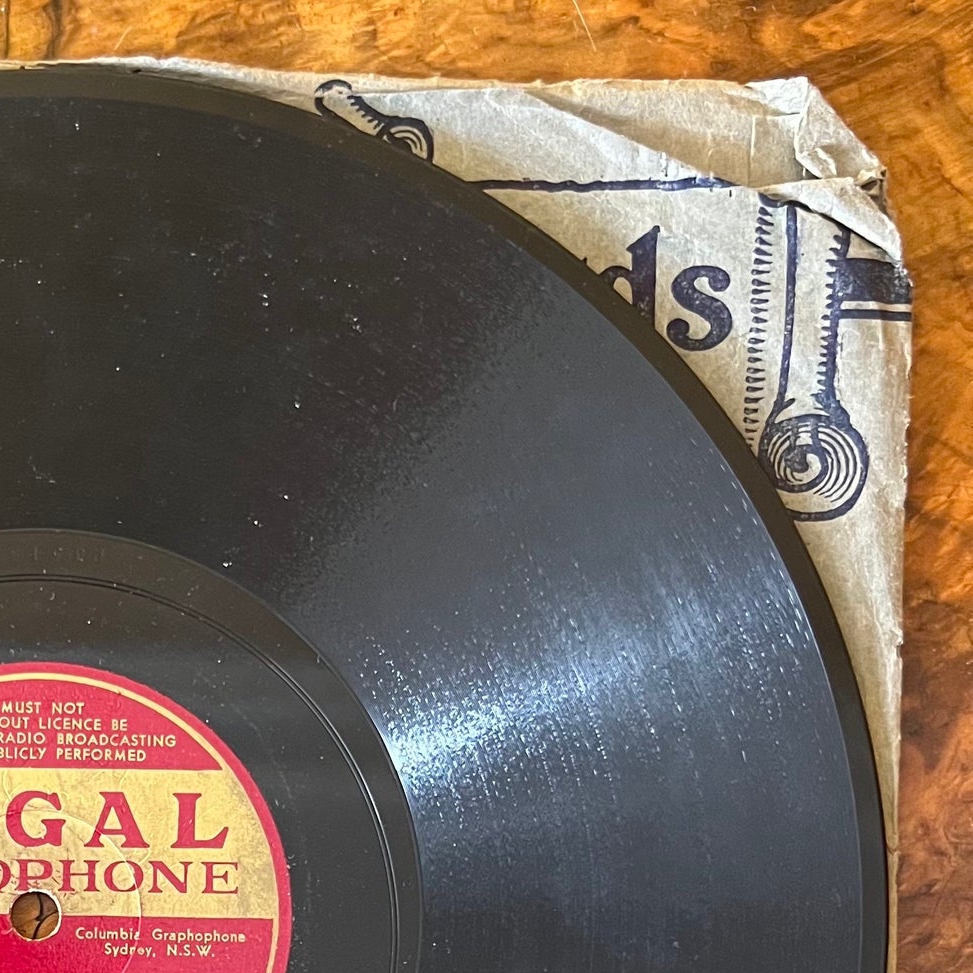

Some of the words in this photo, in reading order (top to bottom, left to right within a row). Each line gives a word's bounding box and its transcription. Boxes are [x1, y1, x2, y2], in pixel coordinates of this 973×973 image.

[583, 225, 732, 350] ds
[2, 701, 41, 714] MUST
[52, 702, 84, 714] NOT
[39, 717, 101, 730] LICENCE
[112, 719, 127, 731] BE
[57, 733, 176, 747] BROADCASTING
[57, 748, 146, 761] PERFORMED
[76, 927, 140, 940] Columbia
[152, 928, 245, 944] Graphophone
[105, 943, 155, 957] Sydney,
[167, 944, 214, 957] N.S.W.
